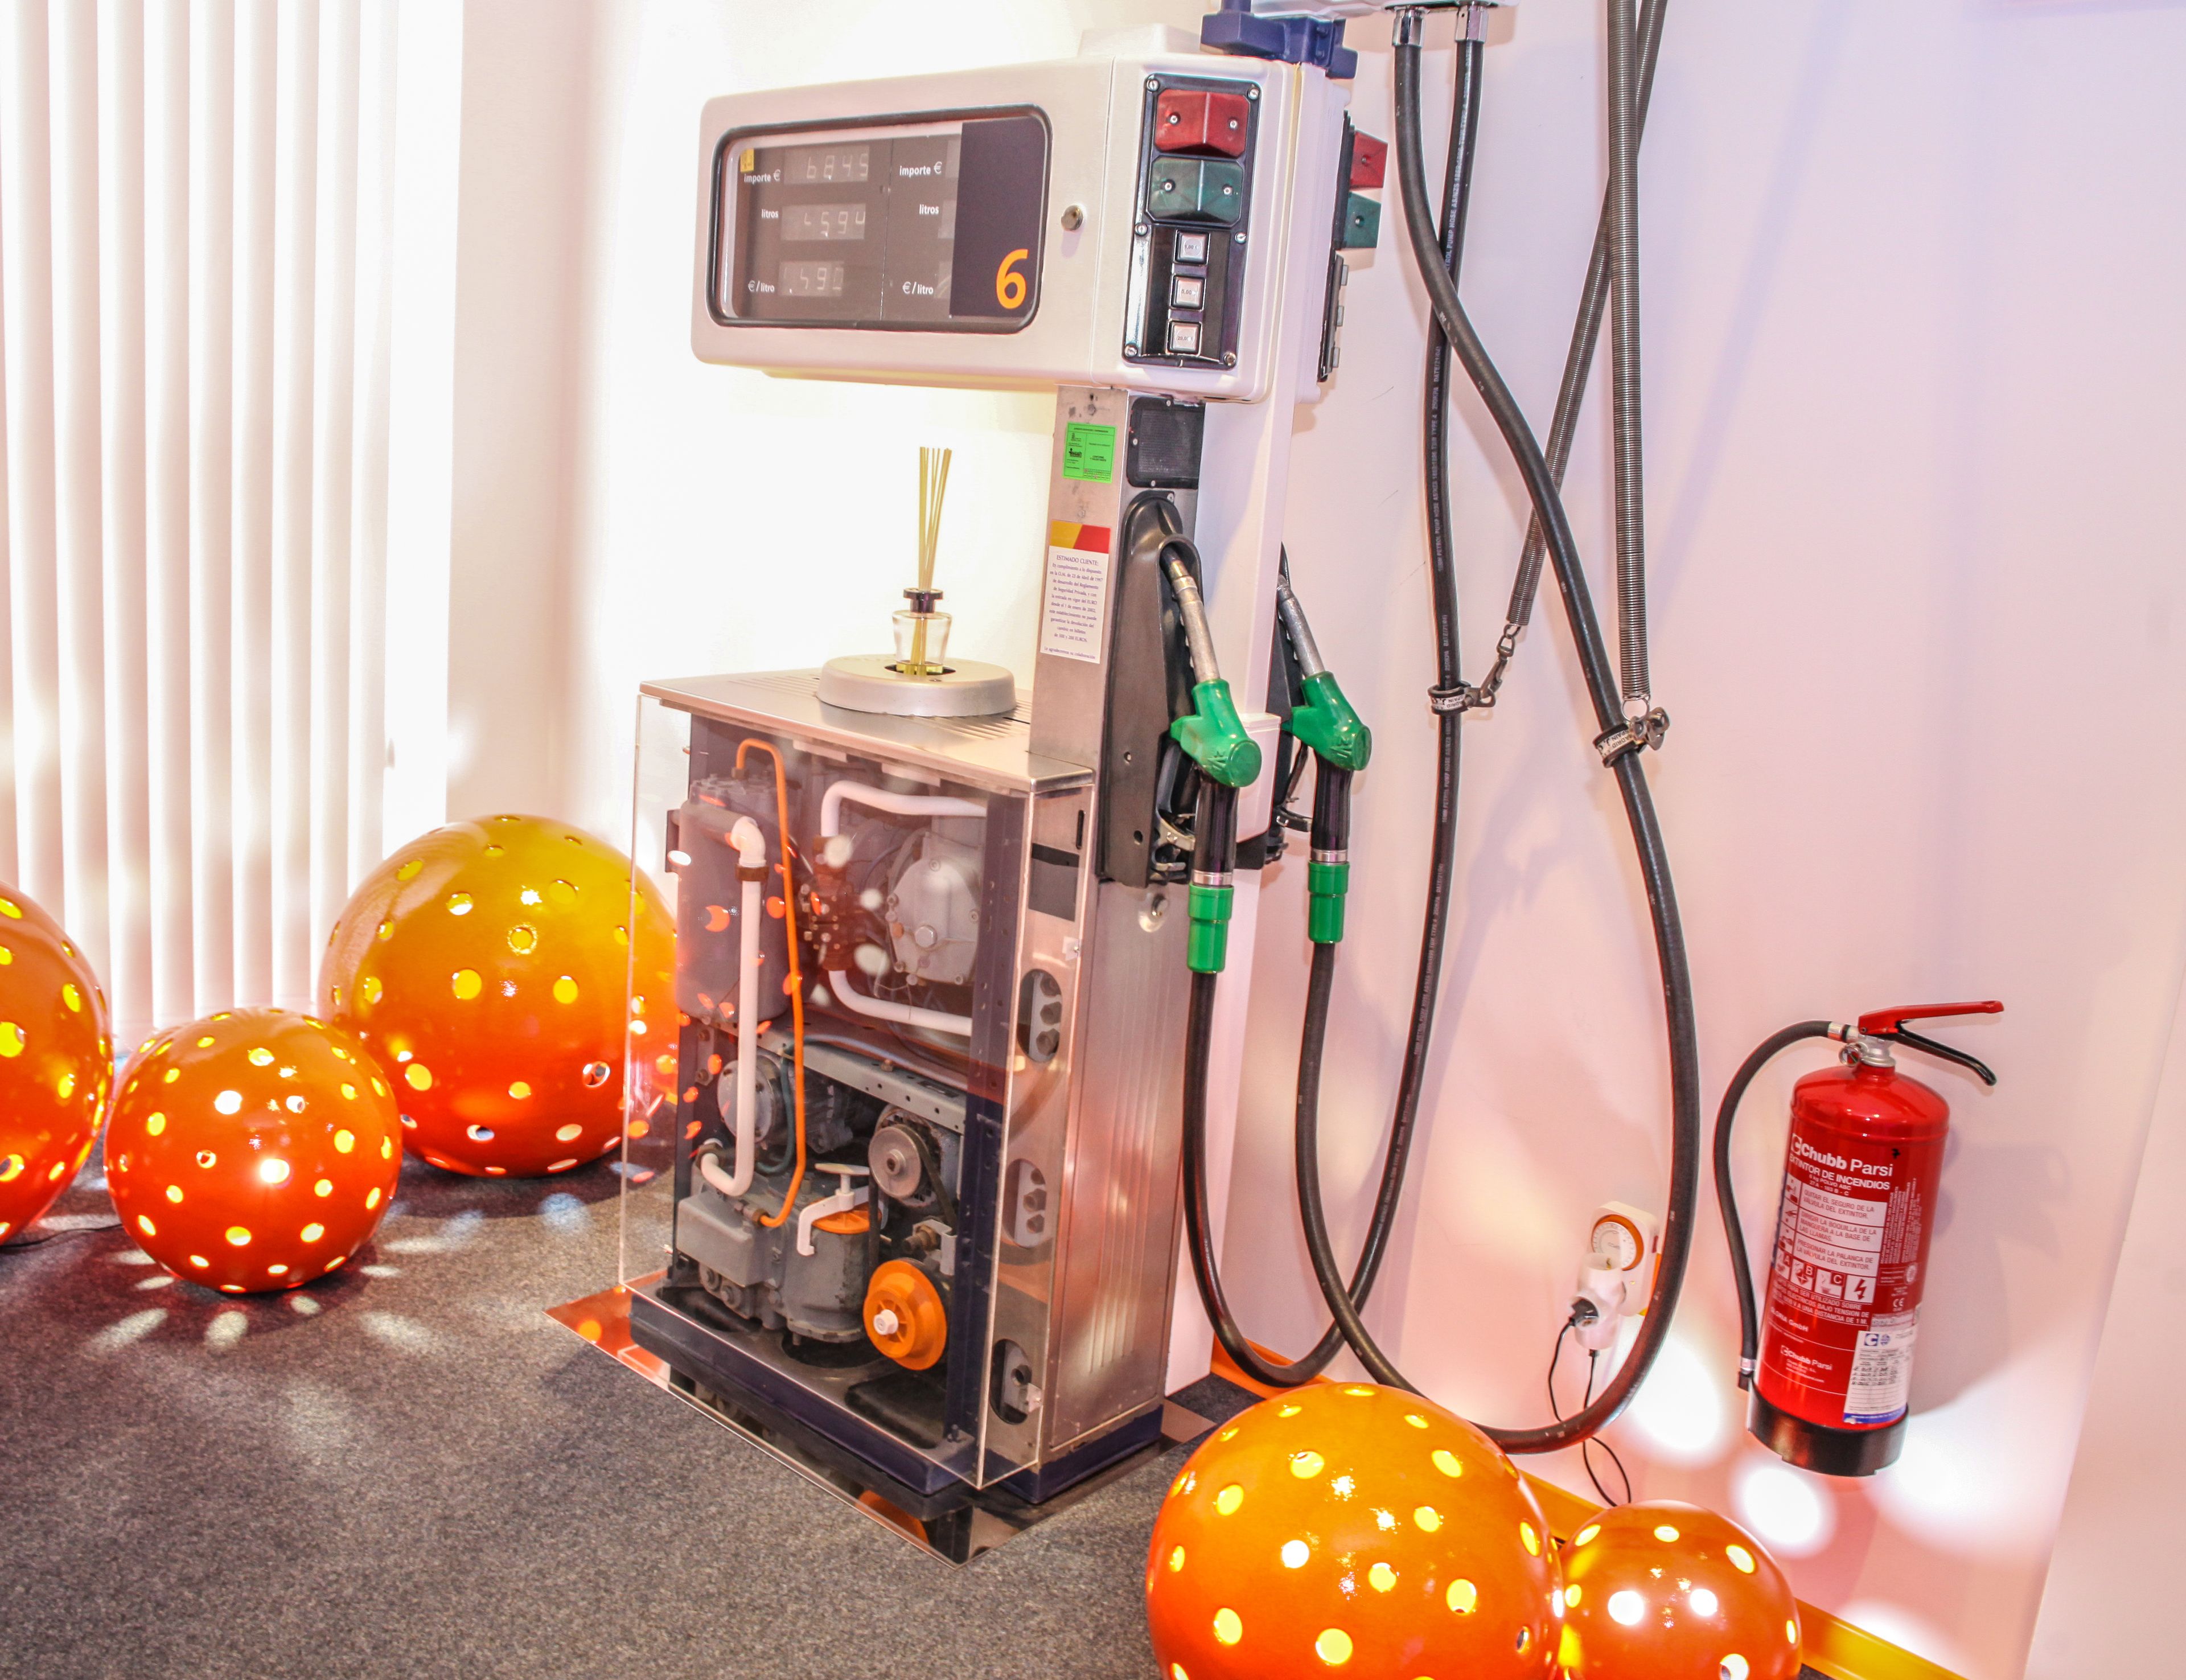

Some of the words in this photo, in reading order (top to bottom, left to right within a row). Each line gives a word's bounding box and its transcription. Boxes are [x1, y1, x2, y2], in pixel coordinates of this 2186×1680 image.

[744, 173, 771, 185] importe
[773, 169, 780, 182] €
[899, 165, 931, 178] importe
[934, 161, 942, 175] €
[761, 208, 779, 219] litros
[919, 204, 939, 215] litros
[996, 248, 1029, 310] 6
[1057, 554, 1079, 563] ESTIMADO
[1801, 1143, 1847, 1169] Chubb
[1850, 1159, 1893, 1176] Parsi
[1789, 1153, 1821, 1176] EXTINTOR
[1822, 1170, 1834, 1181] DE
[1836, 1174, 1891, 1190] INCENDIOS
[1820, 1178, 1838, 1188] POLVO
[1804, 1189, 1821, 1201] QUITAR
[1831, 1200, 1855, 1209] SEGURO
[1826, 1205, 1836, 1213] DEL
[1799, 1225, 1809, 1234] LAS
[1800, 1218, 1828, 1233] MANGUERA
[1844, 1232, 1860, 1241] BASE
[1801, 1211, 1819, 1223] DIRIGIR
[1828, 1220, 1858, 1233] BOQUILLA
[1797, 1239, 1826, 1254] PRESIONAR
[1836, 1252, 1863, 1263] PALANCA
[1827, 1256, 1838, 1266] DEL
[1805, 1265, 1813, 1276] B
[1832, 1274, 1843, 1284] C
[1799, 1287, 1810, 1298] SER
[1811, 1292, 1840, 1307] UTILIZADO
[1841, 1300, 1863, 1311] SOBRE
[1802, 1304, 1814, 1314] UNA
[1814, 1309, 1845, 1322] DISTANCIA
[1817, 1303, 1832, 1313] BAJO
[1788, 1320, 1809, 1333] GmbH
[1786, 1350, 1811, 1365] Chubb
[1811, 1359, 1833, 1371] Parsi
